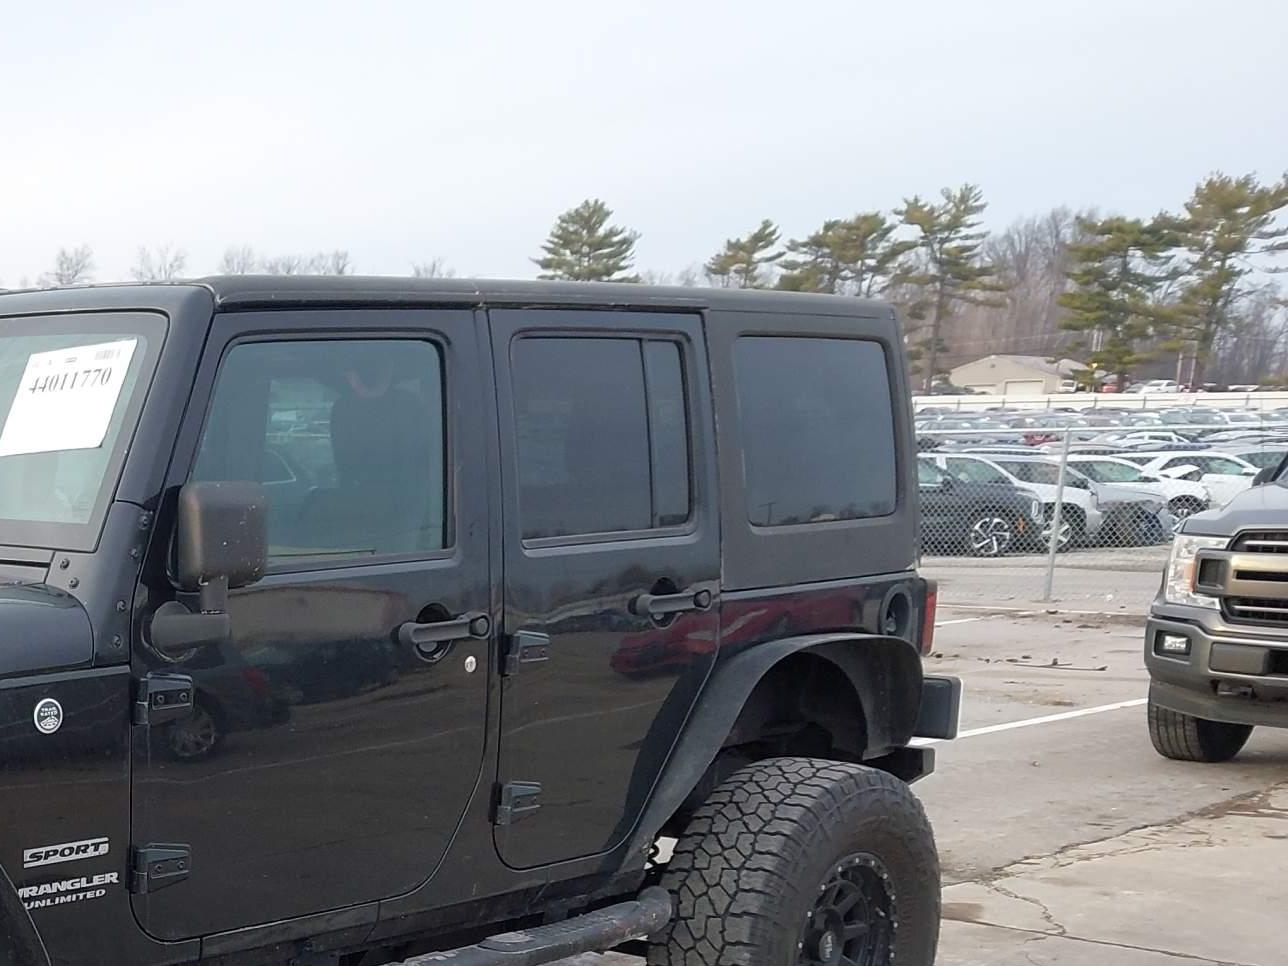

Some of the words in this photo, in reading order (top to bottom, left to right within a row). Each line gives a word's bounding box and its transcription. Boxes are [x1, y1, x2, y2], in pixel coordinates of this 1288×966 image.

[28, 367, 112, 394] 44011770
[28, 842, 103, 863] SPORT
[24, 889, 106, 910] UNLIMITED
